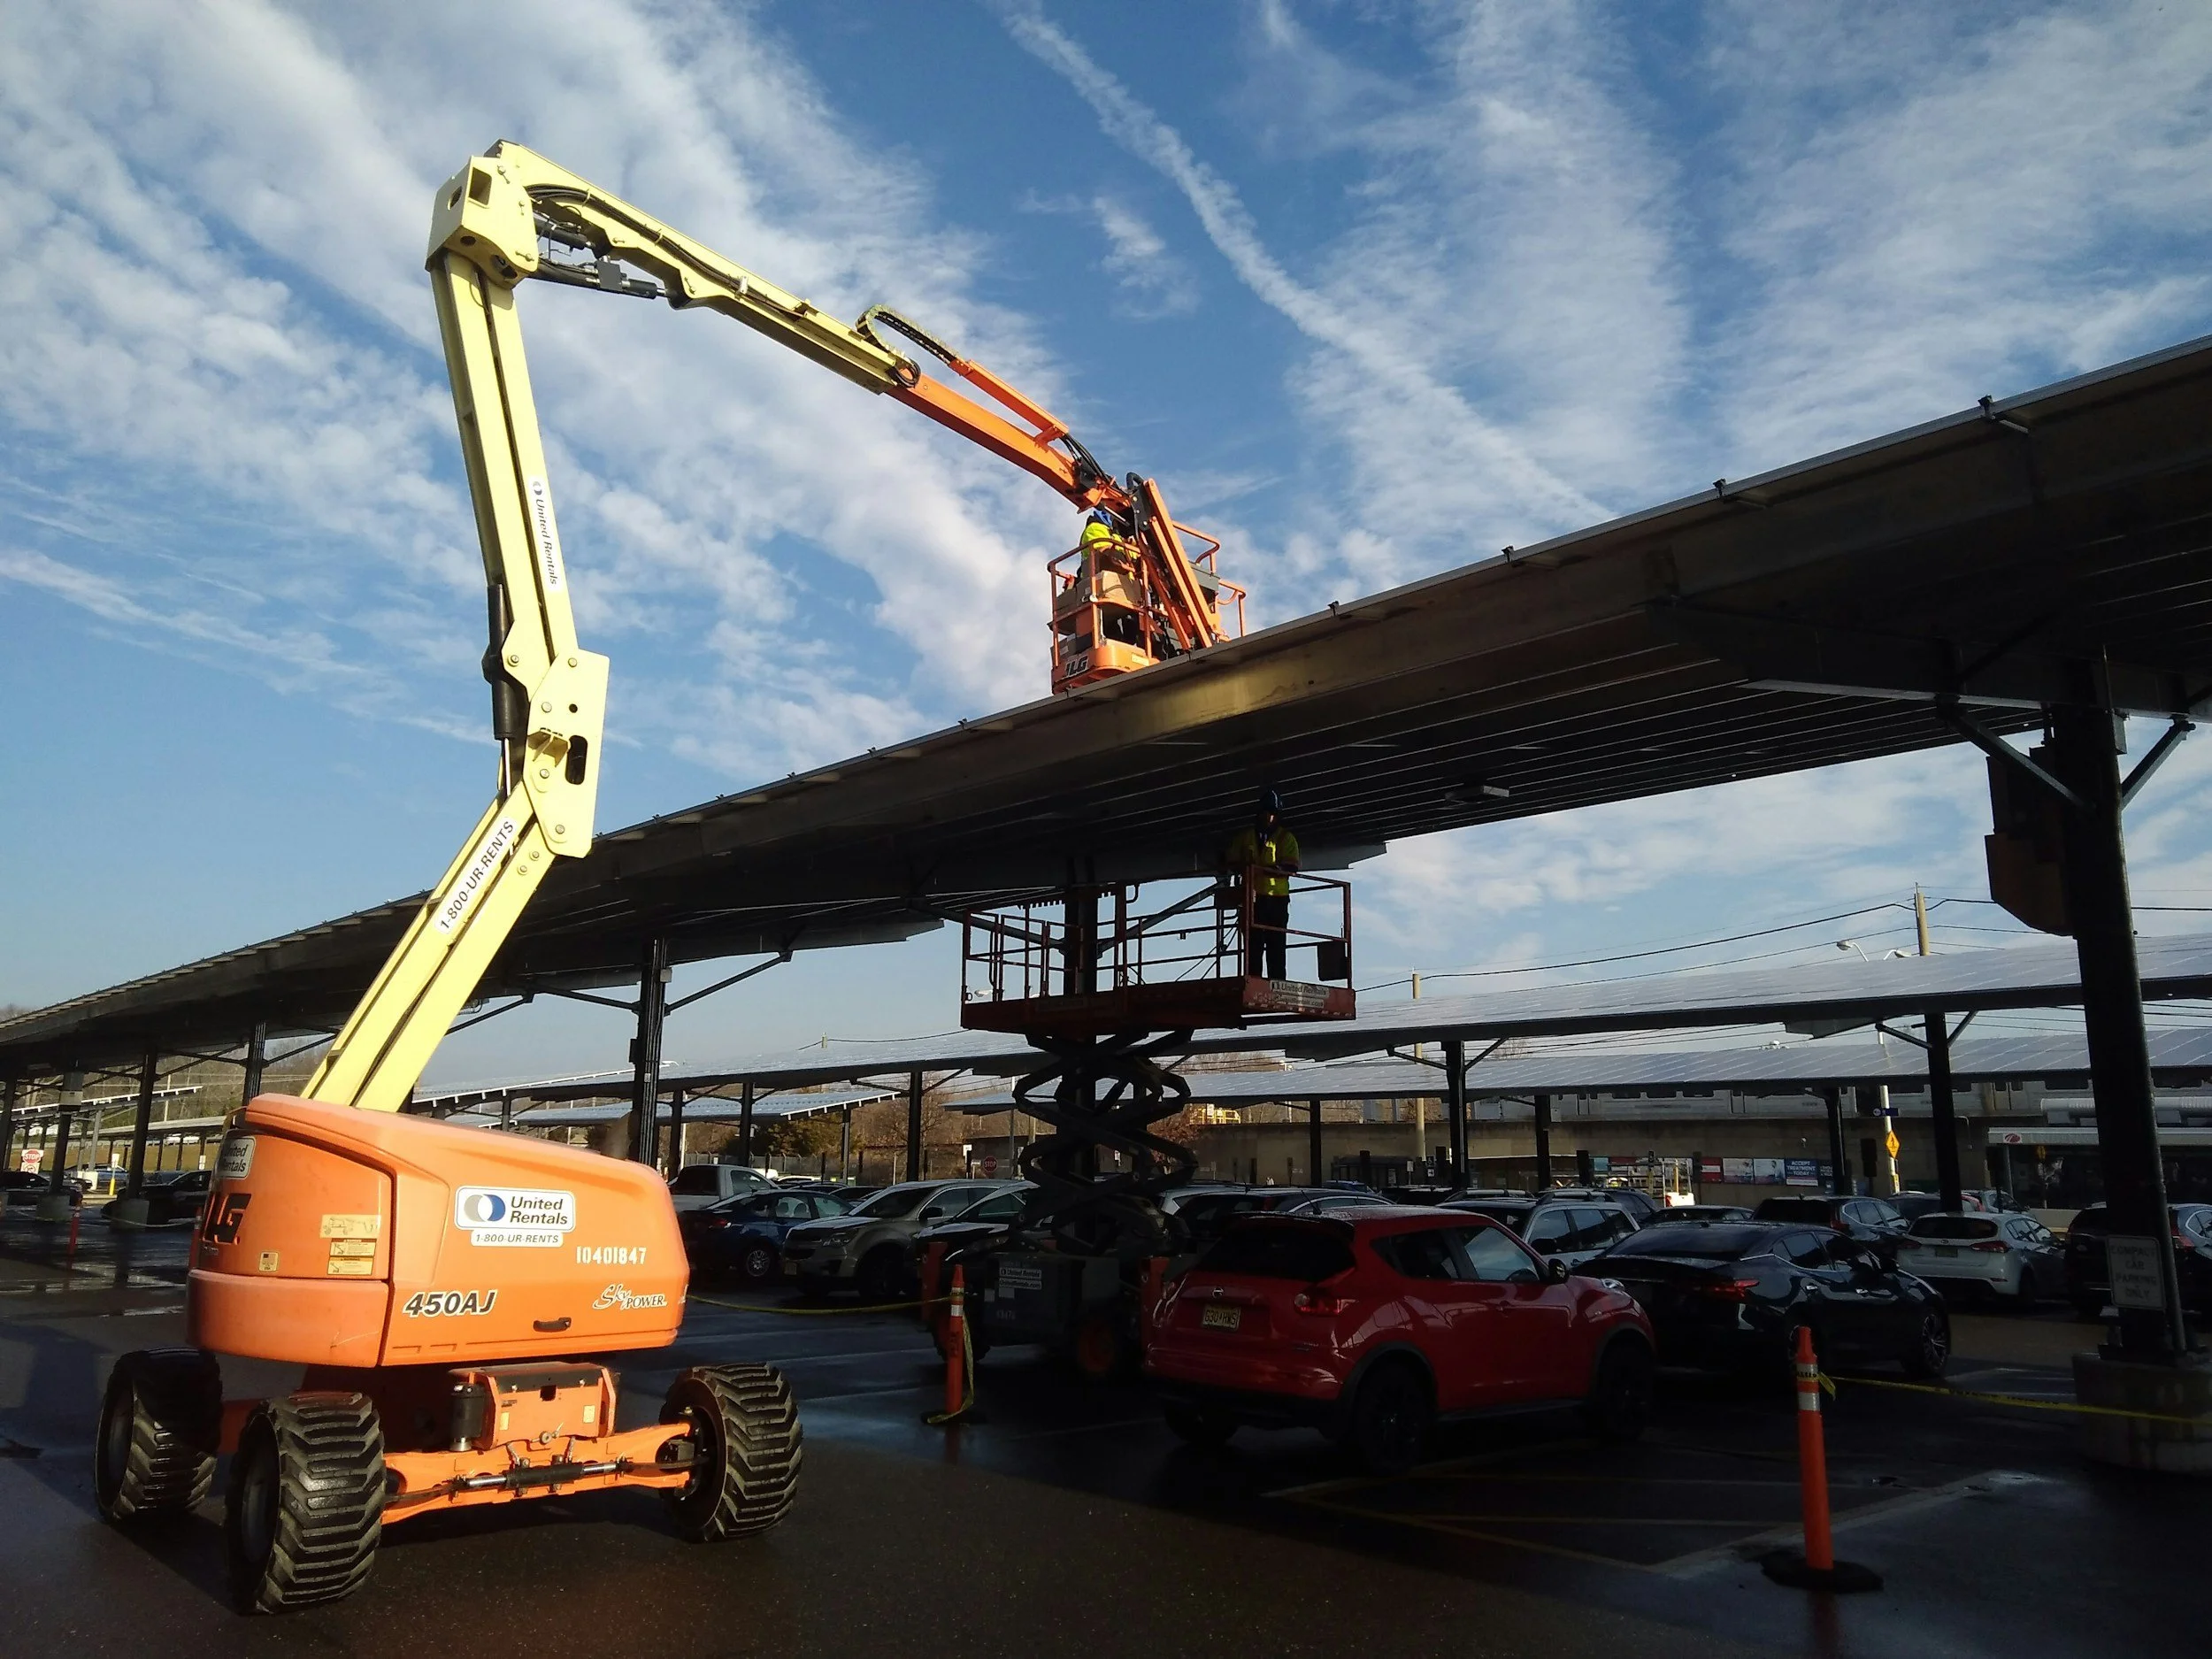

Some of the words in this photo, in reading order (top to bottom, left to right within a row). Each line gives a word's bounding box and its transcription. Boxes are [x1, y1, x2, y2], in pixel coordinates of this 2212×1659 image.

[535, 498, 550, 539] United
[543, 541, 558, 585] Rentals
[440, 821, 514, 929] 1-800-UR-RENTS
[511, 1196, 564, 1210] United
[510, 1210, 568, 1225] Rentals
[475, 1233, 559, 1243] 1-800-UR-RENTS
[576, 1246, 647, 1264] 10401847
[2125, 1260, 2145, 1270] CAR
[2125, 1287, 2150, 1299] ONLY
[403, 1289, 497, 1317] 450AJ
